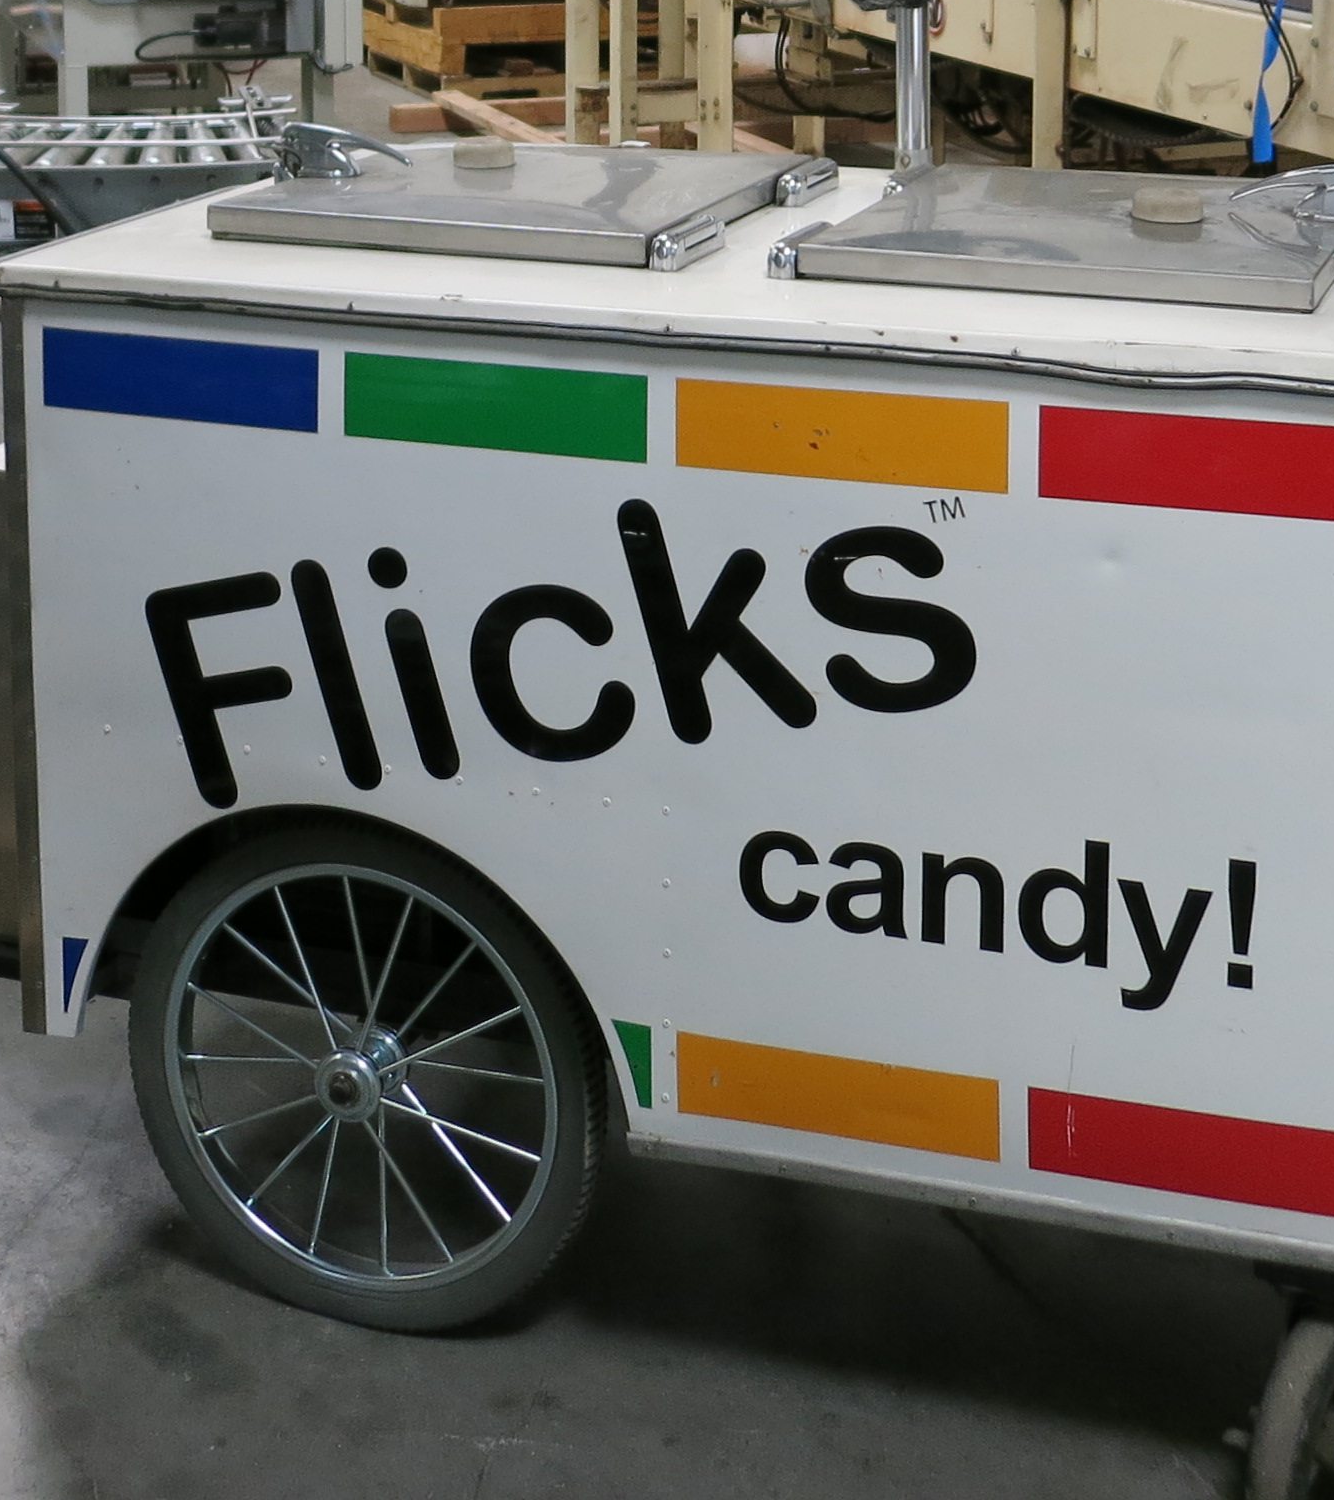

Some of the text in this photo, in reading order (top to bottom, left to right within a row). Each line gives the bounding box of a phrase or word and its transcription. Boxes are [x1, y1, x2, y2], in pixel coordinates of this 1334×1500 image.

[144, 496, 978, 810] Flicks TM
[738, 830, 1257, 1011] candy!
